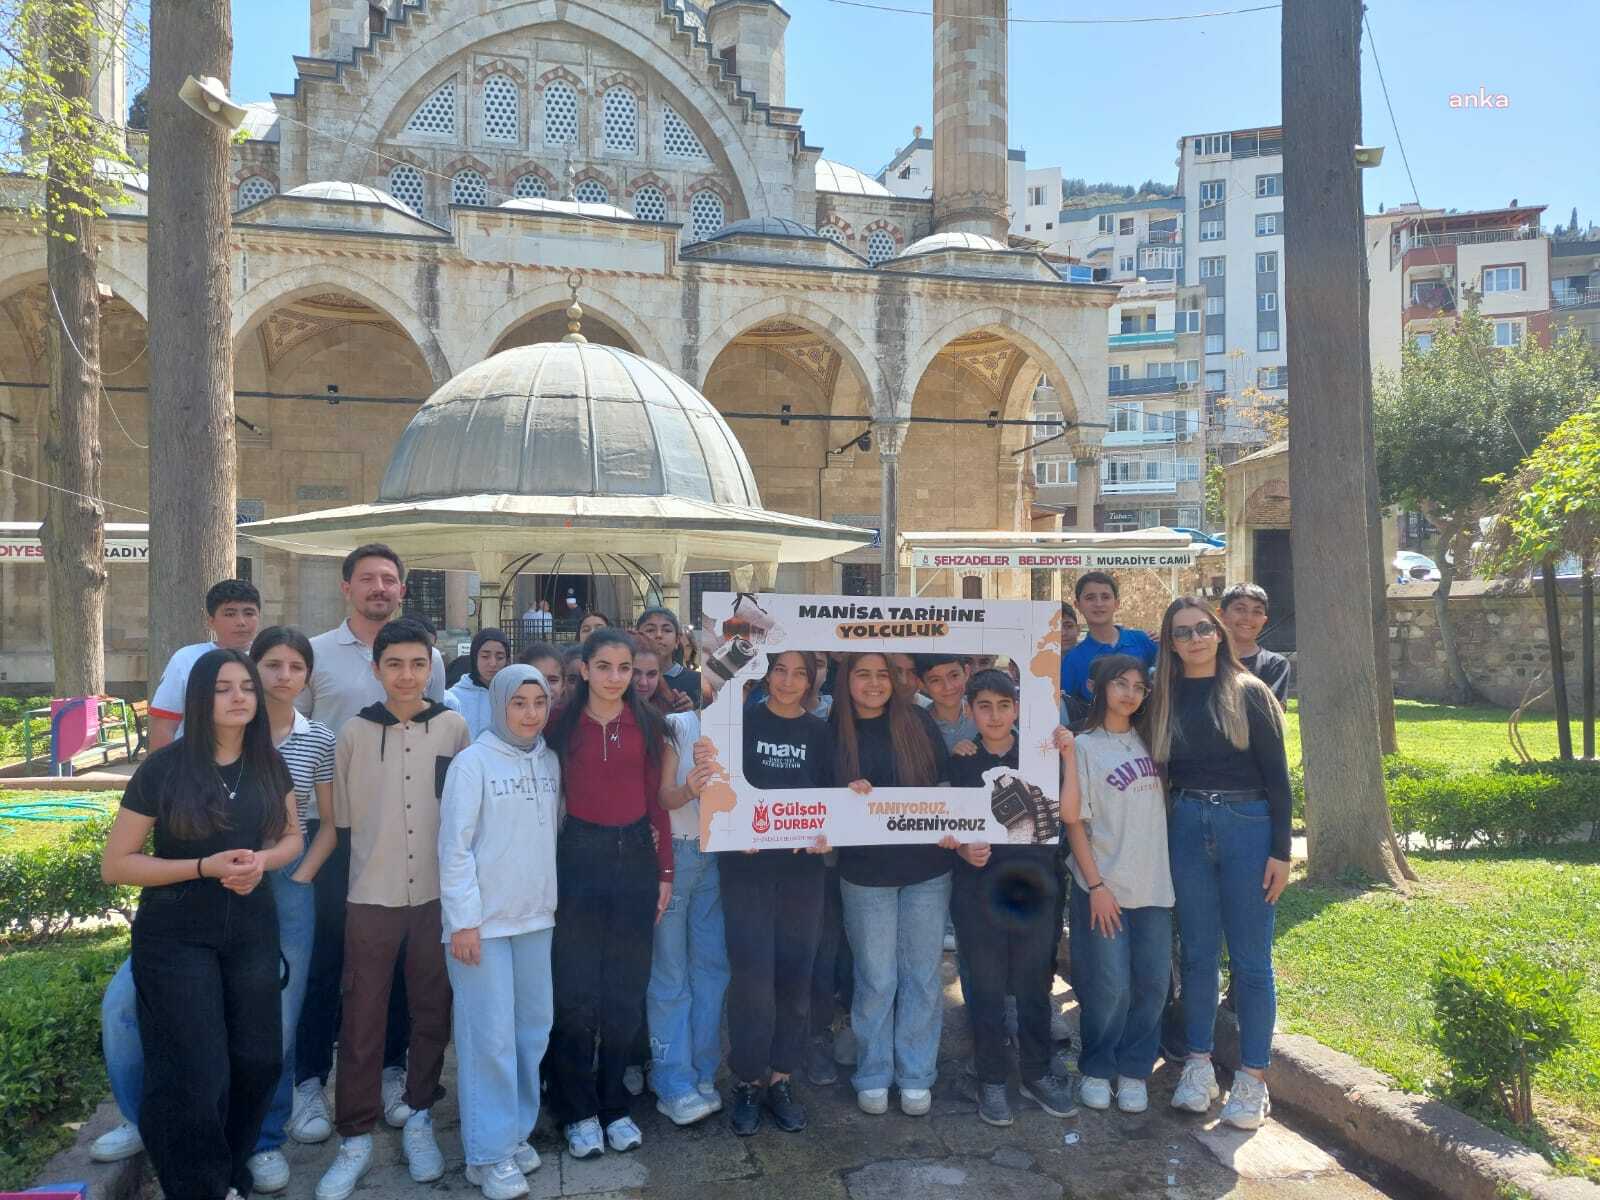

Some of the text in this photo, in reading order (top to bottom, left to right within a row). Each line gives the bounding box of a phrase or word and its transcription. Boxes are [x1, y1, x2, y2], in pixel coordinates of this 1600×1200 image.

[0, 545, 45, 557] DIYES
[934, 555, 1010, 567] ŞEHZADELER
[1097, 554, 1156, 566] MURADİYE
[798, 603, 986, 623] MANİSA TARİHİNE
[839, 622, 945, 638] YOLCULUK
[757, 740, 806, 760] mavi
[1106, 761, 1138, 791] SAN
[490, 777, 557, 796] LIMITED
[774, 818, 825, 831] DURBAY
[887, 814, 986, 832] ÖĞRENİYORUZ
